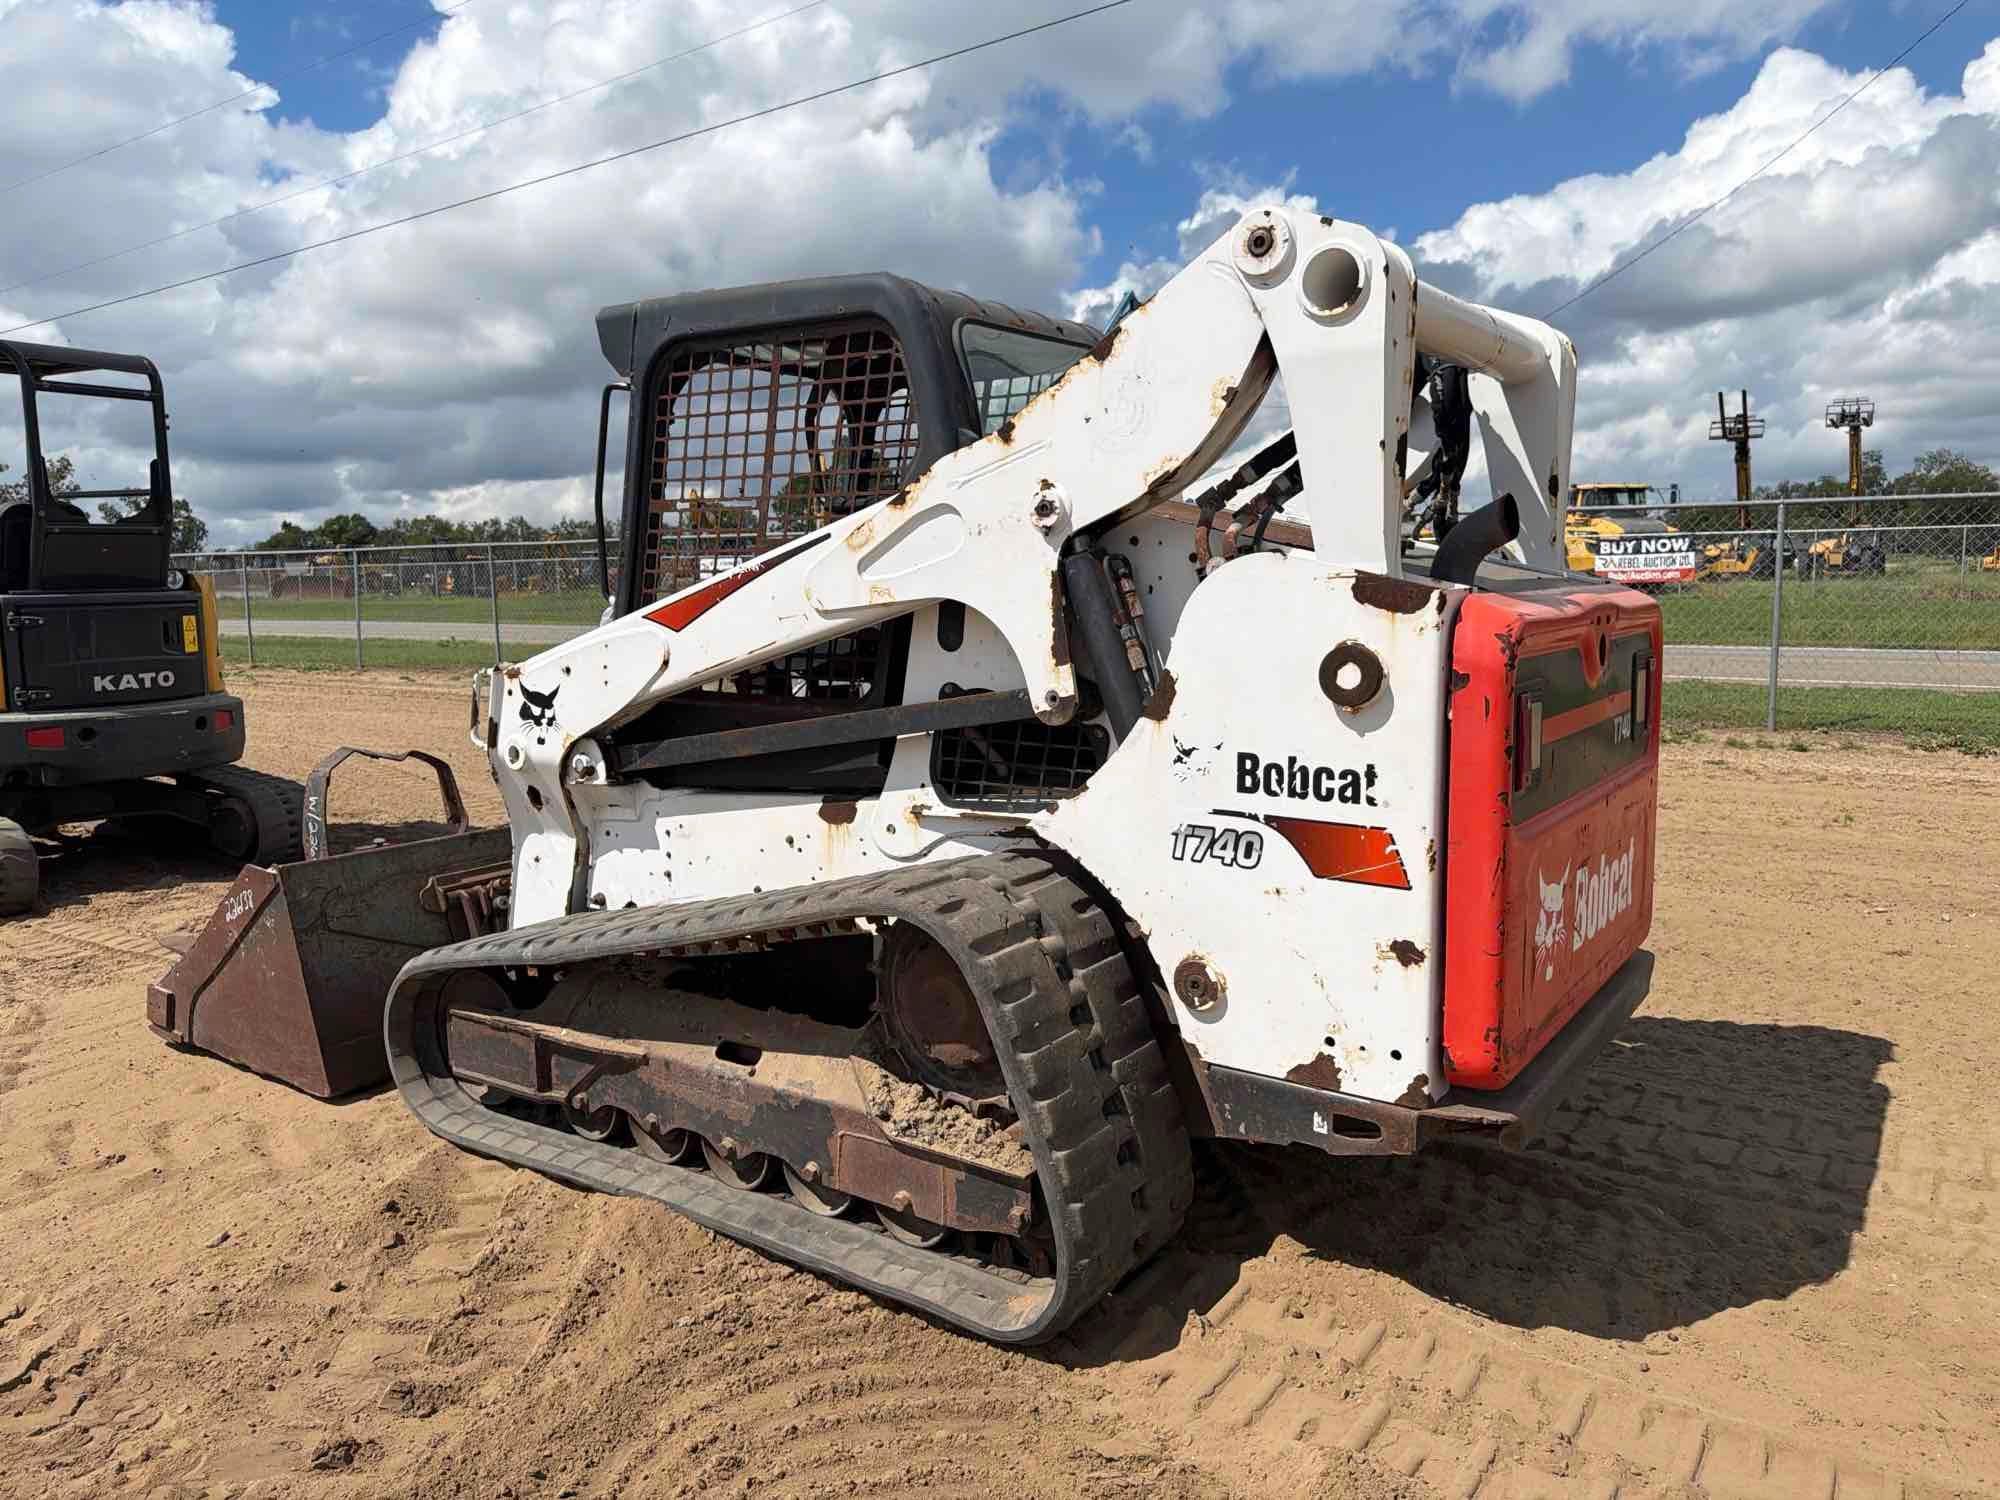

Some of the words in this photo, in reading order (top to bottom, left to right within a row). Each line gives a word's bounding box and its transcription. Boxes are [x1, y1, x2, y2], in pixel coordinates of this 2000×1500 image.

[1600, 541, 1636, 554] BUY
[1641, 538, 1689, 553] NOW
[1617, 556, 1640, 569] REBEL
[1643, 555, 1677, 568] AUCTION
[93, 670, 175, 692] KATO
[1236, 751, 1379, 807] Bobcat
[1573, 837, 1635, 952] Bobcat
